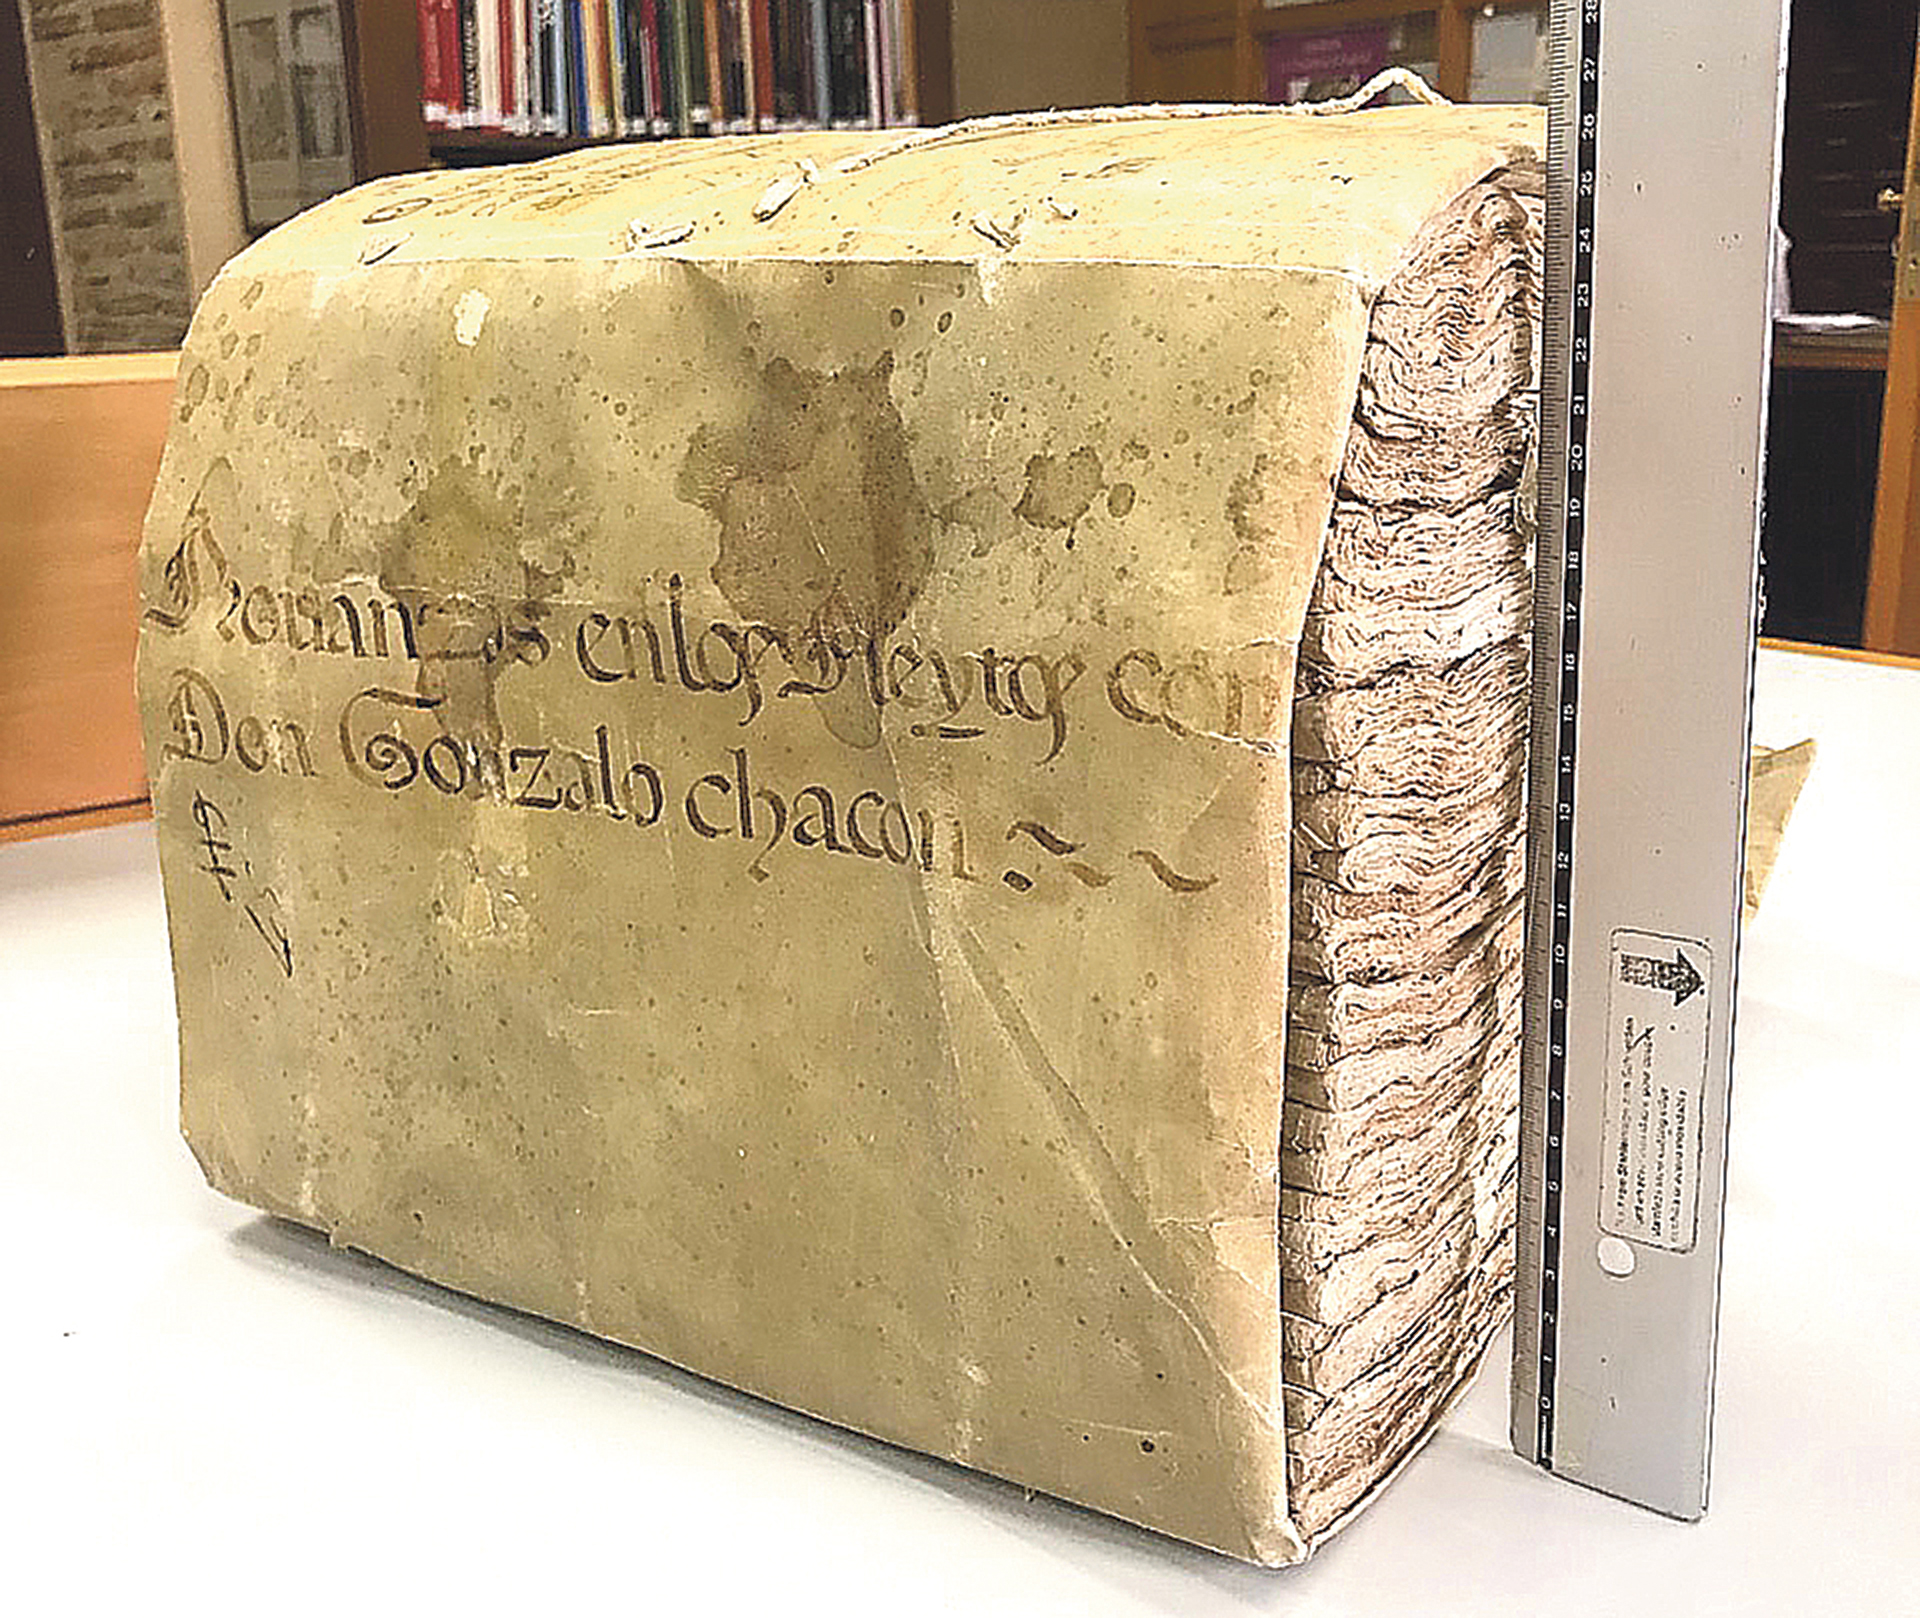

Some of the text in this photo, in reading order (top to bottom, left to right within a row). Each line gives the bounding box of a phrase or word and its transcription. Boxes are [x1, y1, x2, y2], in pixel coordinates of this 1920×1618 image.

[1583, 57, 1597, 82] 27
[1579, 227, 1592, 253] 24
[1577, 282, 1589, 307] 23
[1575, 336, 1588, 363] 22
[1573, 395, 1585, 415] 21
[1571, 444, 1583, 471] 20
[1568, 551, 1579, 569] 18
[1566, 602, 1577, 621] 17
[160, 668, 316, 778] Don
[339, 687, 664, 827] Gonzalo
[1559, 803, 1570, 821] 13
[1557, 852, 1569, 869] 12
[1557, 903, 1567, 918] 11
[1554, 944, 1565, 964] 10
